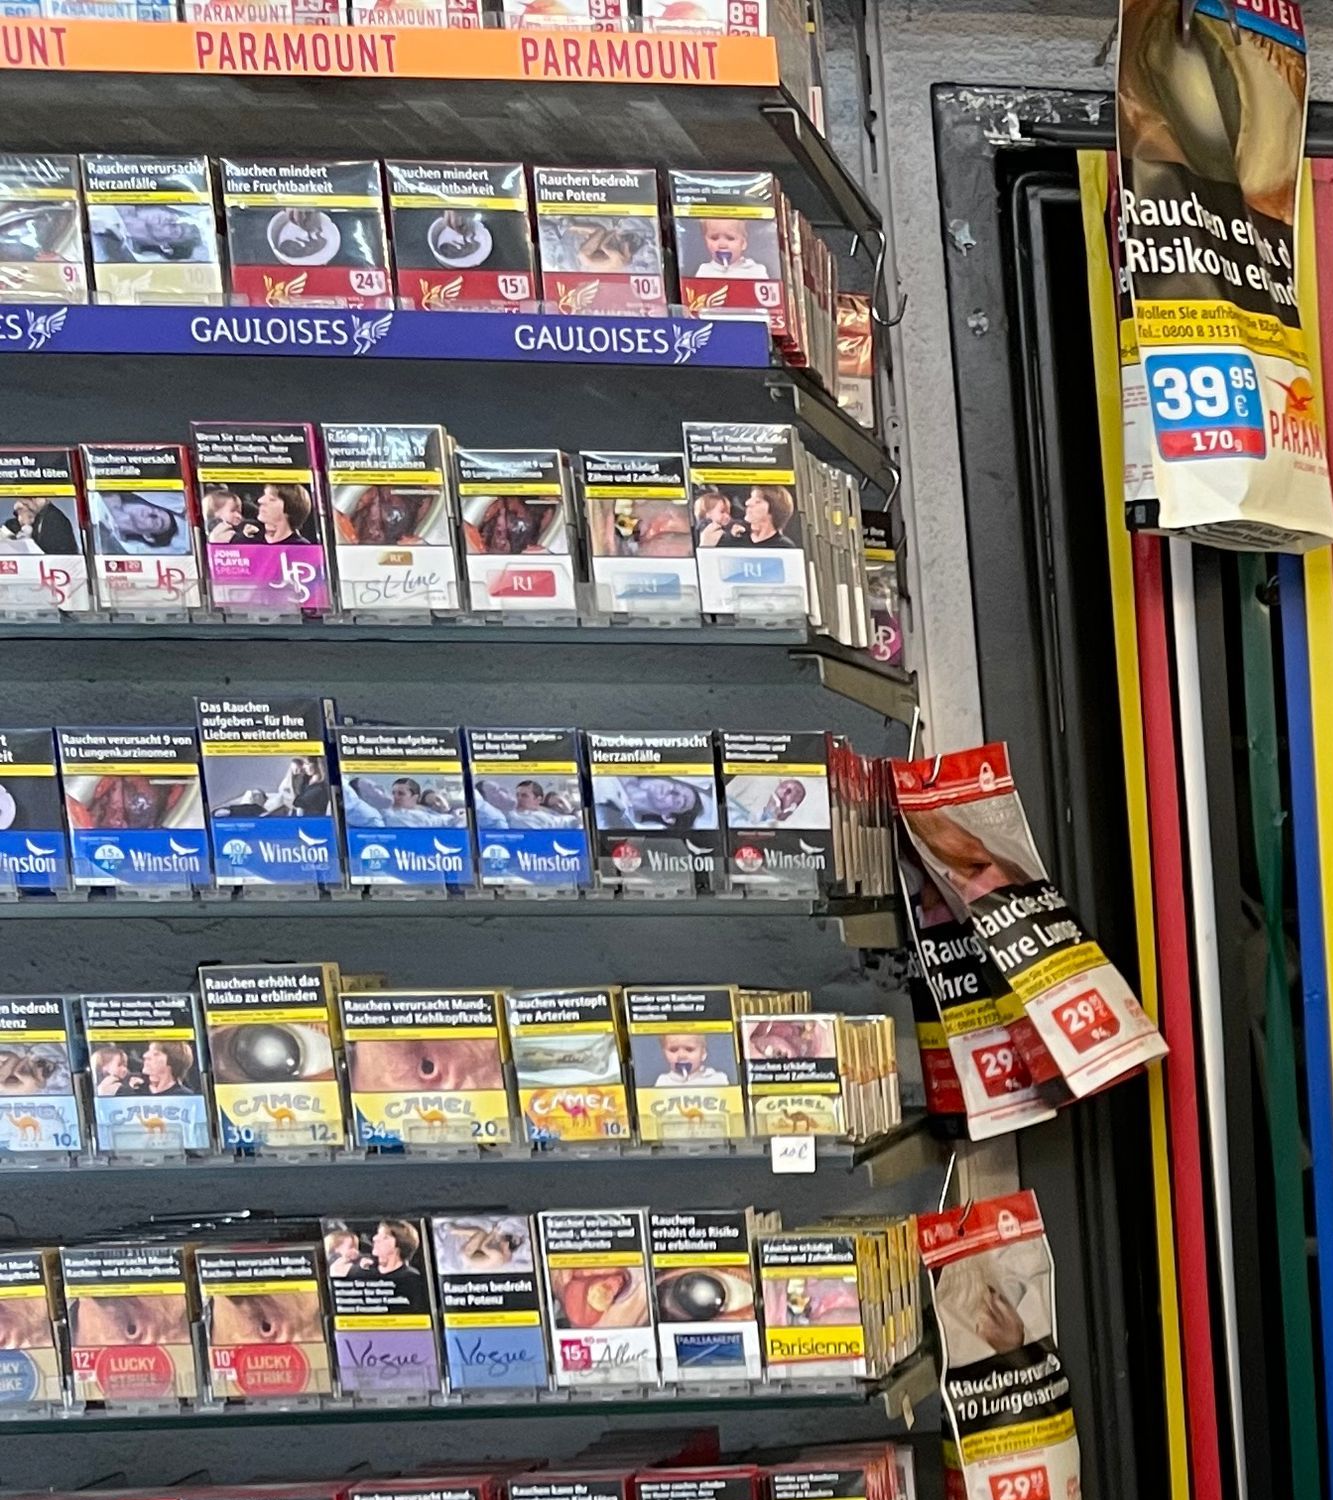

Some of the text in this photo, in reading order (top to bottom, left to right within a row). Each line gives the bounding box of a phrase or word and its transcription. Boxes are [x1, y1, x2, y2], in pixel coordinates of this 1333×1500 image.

[197, 33, 397, 74] PARAMOUNT
[521, 37, 718, 79] PARAMOUNT
[539, 173, 639, 188] Rauchen bedroht
[540, 189, 606, 203] Ihre Potenz
[191, 315, 349, 347] GAULOISES
[515, 324, 669, 355] GAULOISES
[62, 734, 191, 745] Rauchen verursacht 9 von
[78, 748, 176, 760] Lungenkarzinomen
[130, 847, 199, 873] Winston
[769, 1337, 861, 1359] Parisienne
